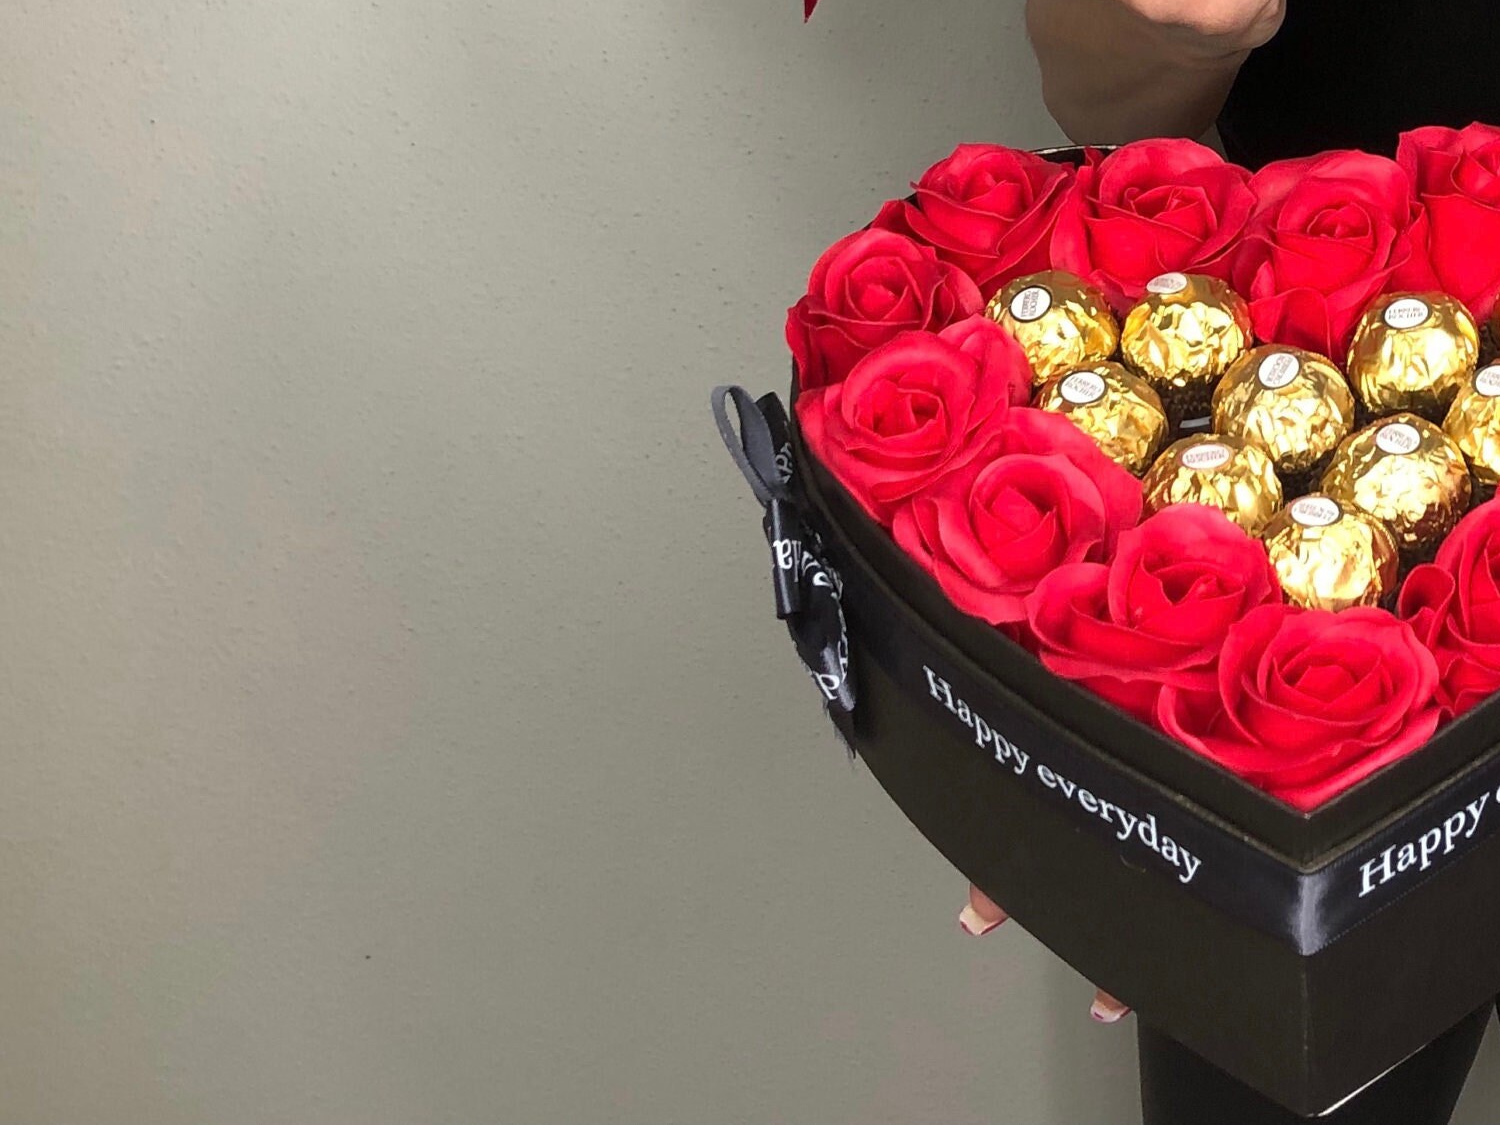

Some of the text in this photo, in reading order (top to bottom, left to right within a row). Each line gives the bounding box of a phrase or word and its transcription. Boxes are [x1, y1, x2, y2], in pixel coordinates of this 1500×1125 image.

[922, 665, 1202, 883] Happy everyday
[1358, 789, 1490, 898] Happy
